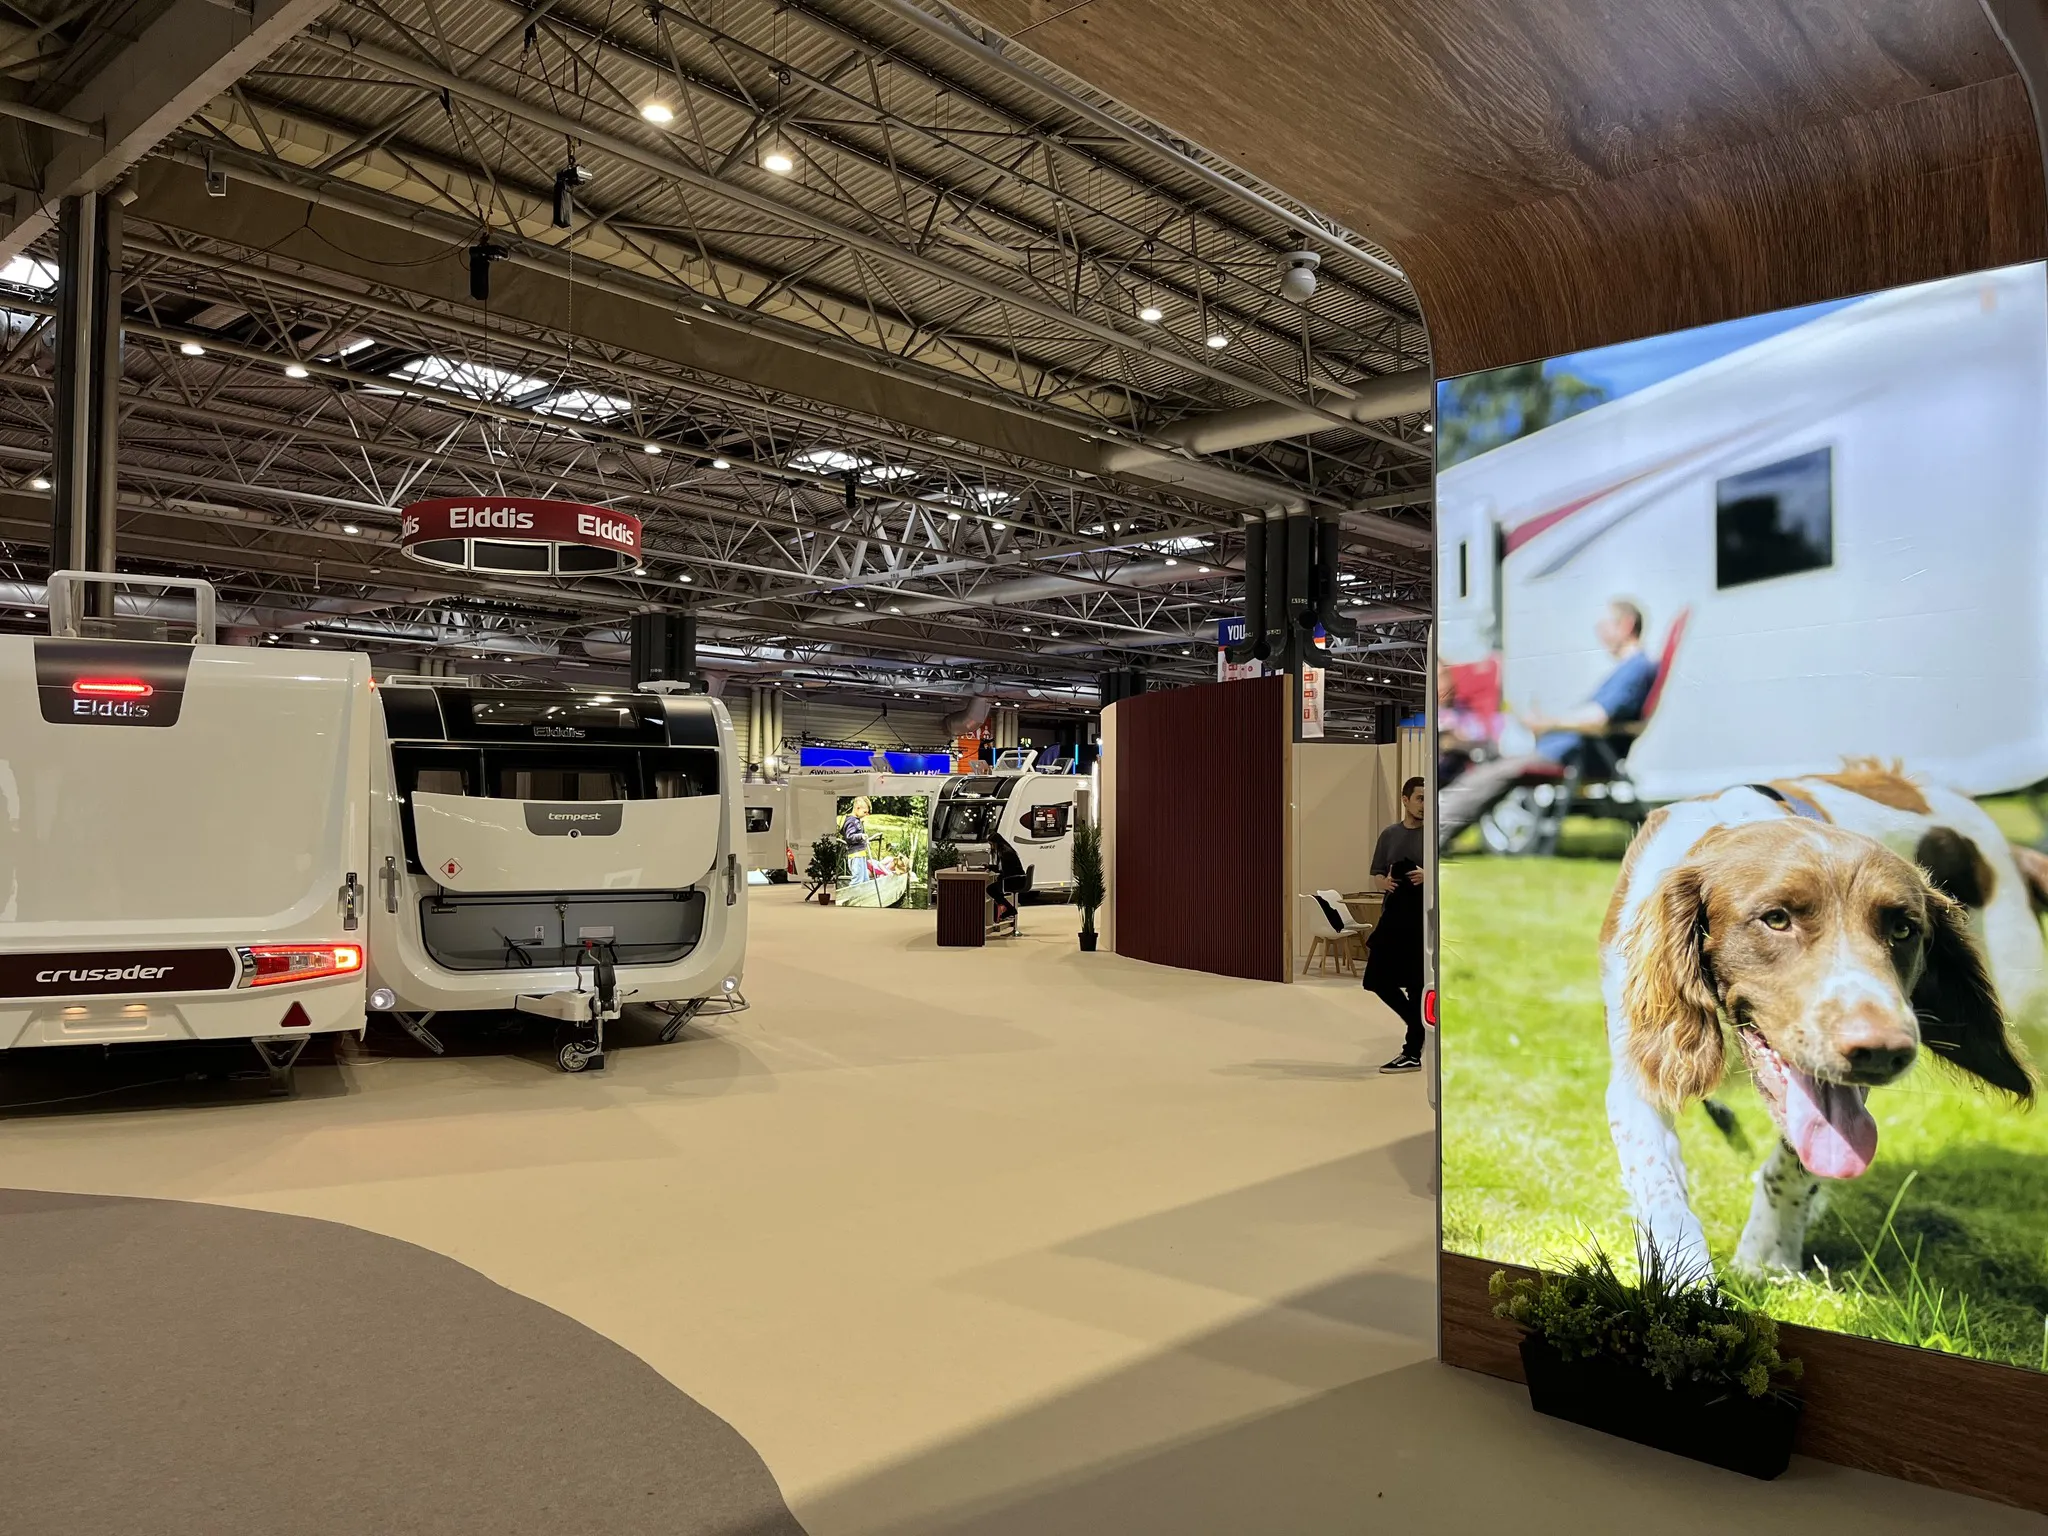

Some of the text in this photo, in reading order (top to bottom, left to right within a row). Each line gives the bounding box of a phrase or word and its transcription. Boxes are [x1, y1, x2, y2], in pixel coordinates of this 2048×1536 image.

[450, 507, 534, 529] Elddis
[577, 513, 634, 546] Elddis
[73, 699, 150, 717] Elddis
[533, 726, 586, 738] Elddis
[548, 812, 602, 822] tempest
[36, 964, 174, 983] crusader
